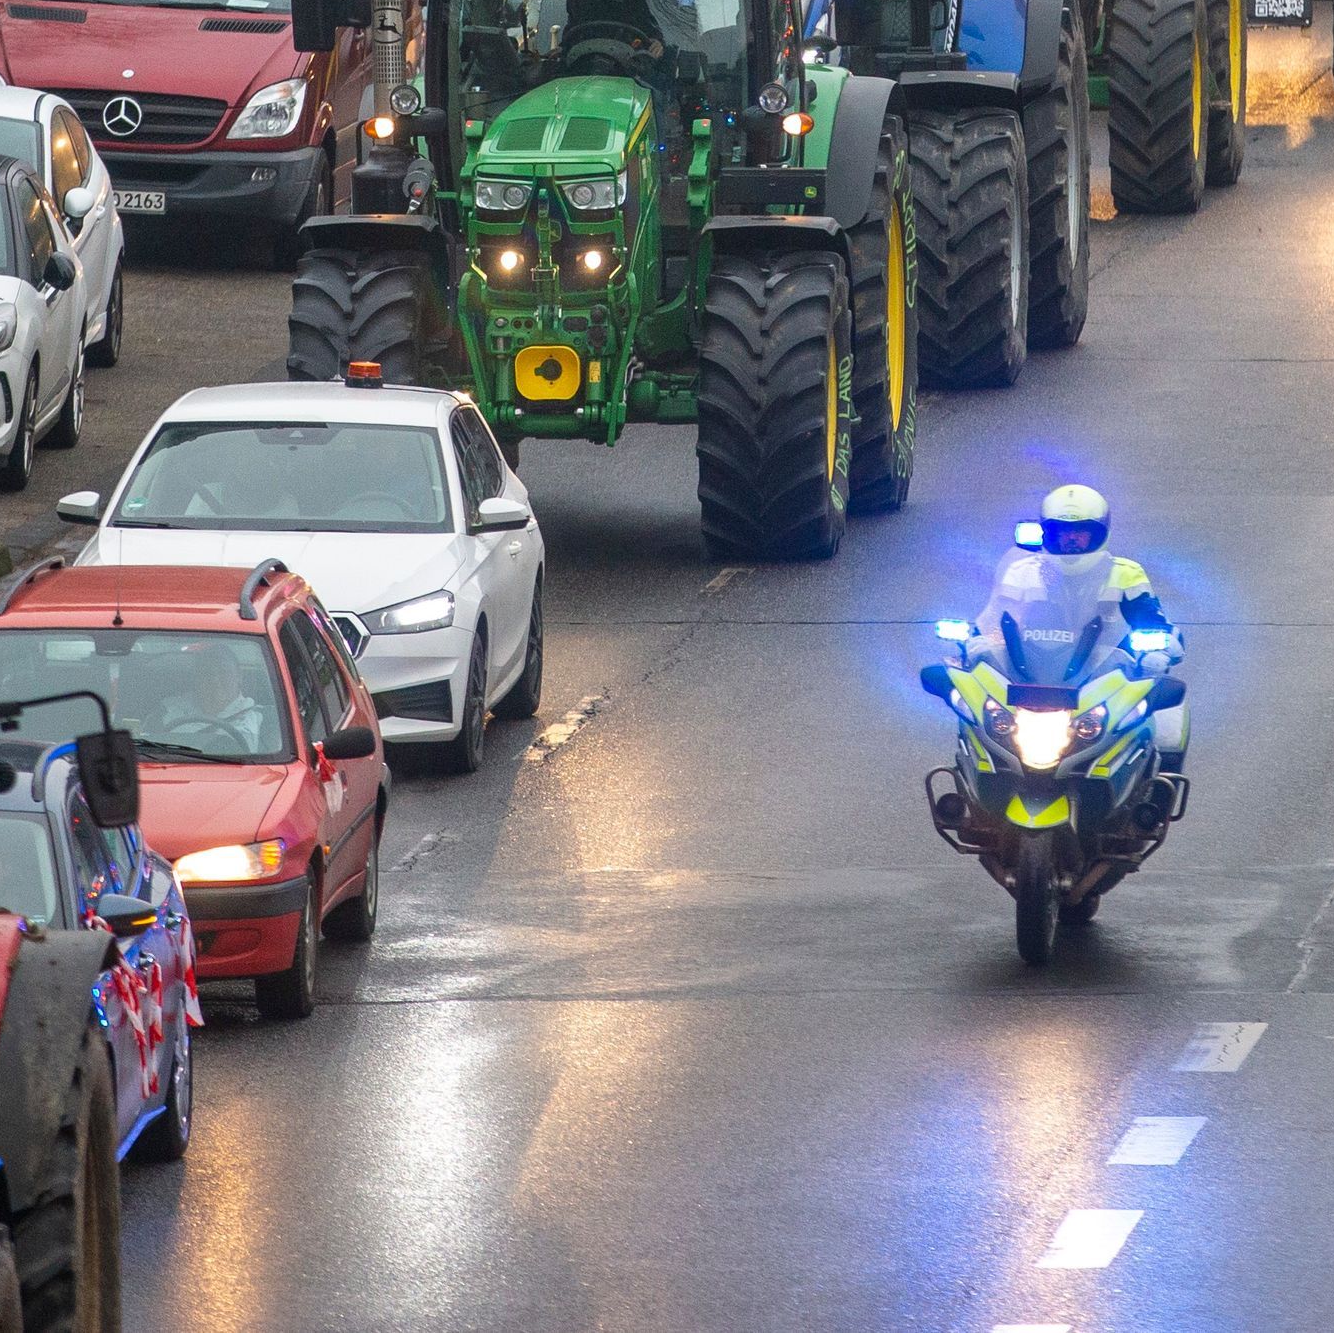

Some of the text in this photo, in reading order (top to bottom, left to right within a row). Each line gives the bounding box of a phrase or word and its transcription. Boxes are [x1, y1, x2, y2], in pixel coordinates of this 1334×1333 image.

[123, 193, 163, 209] 2163
[835, 354, 854, 478] DAS LAND
[1023, 629, 1075, 644] POLIZEI
